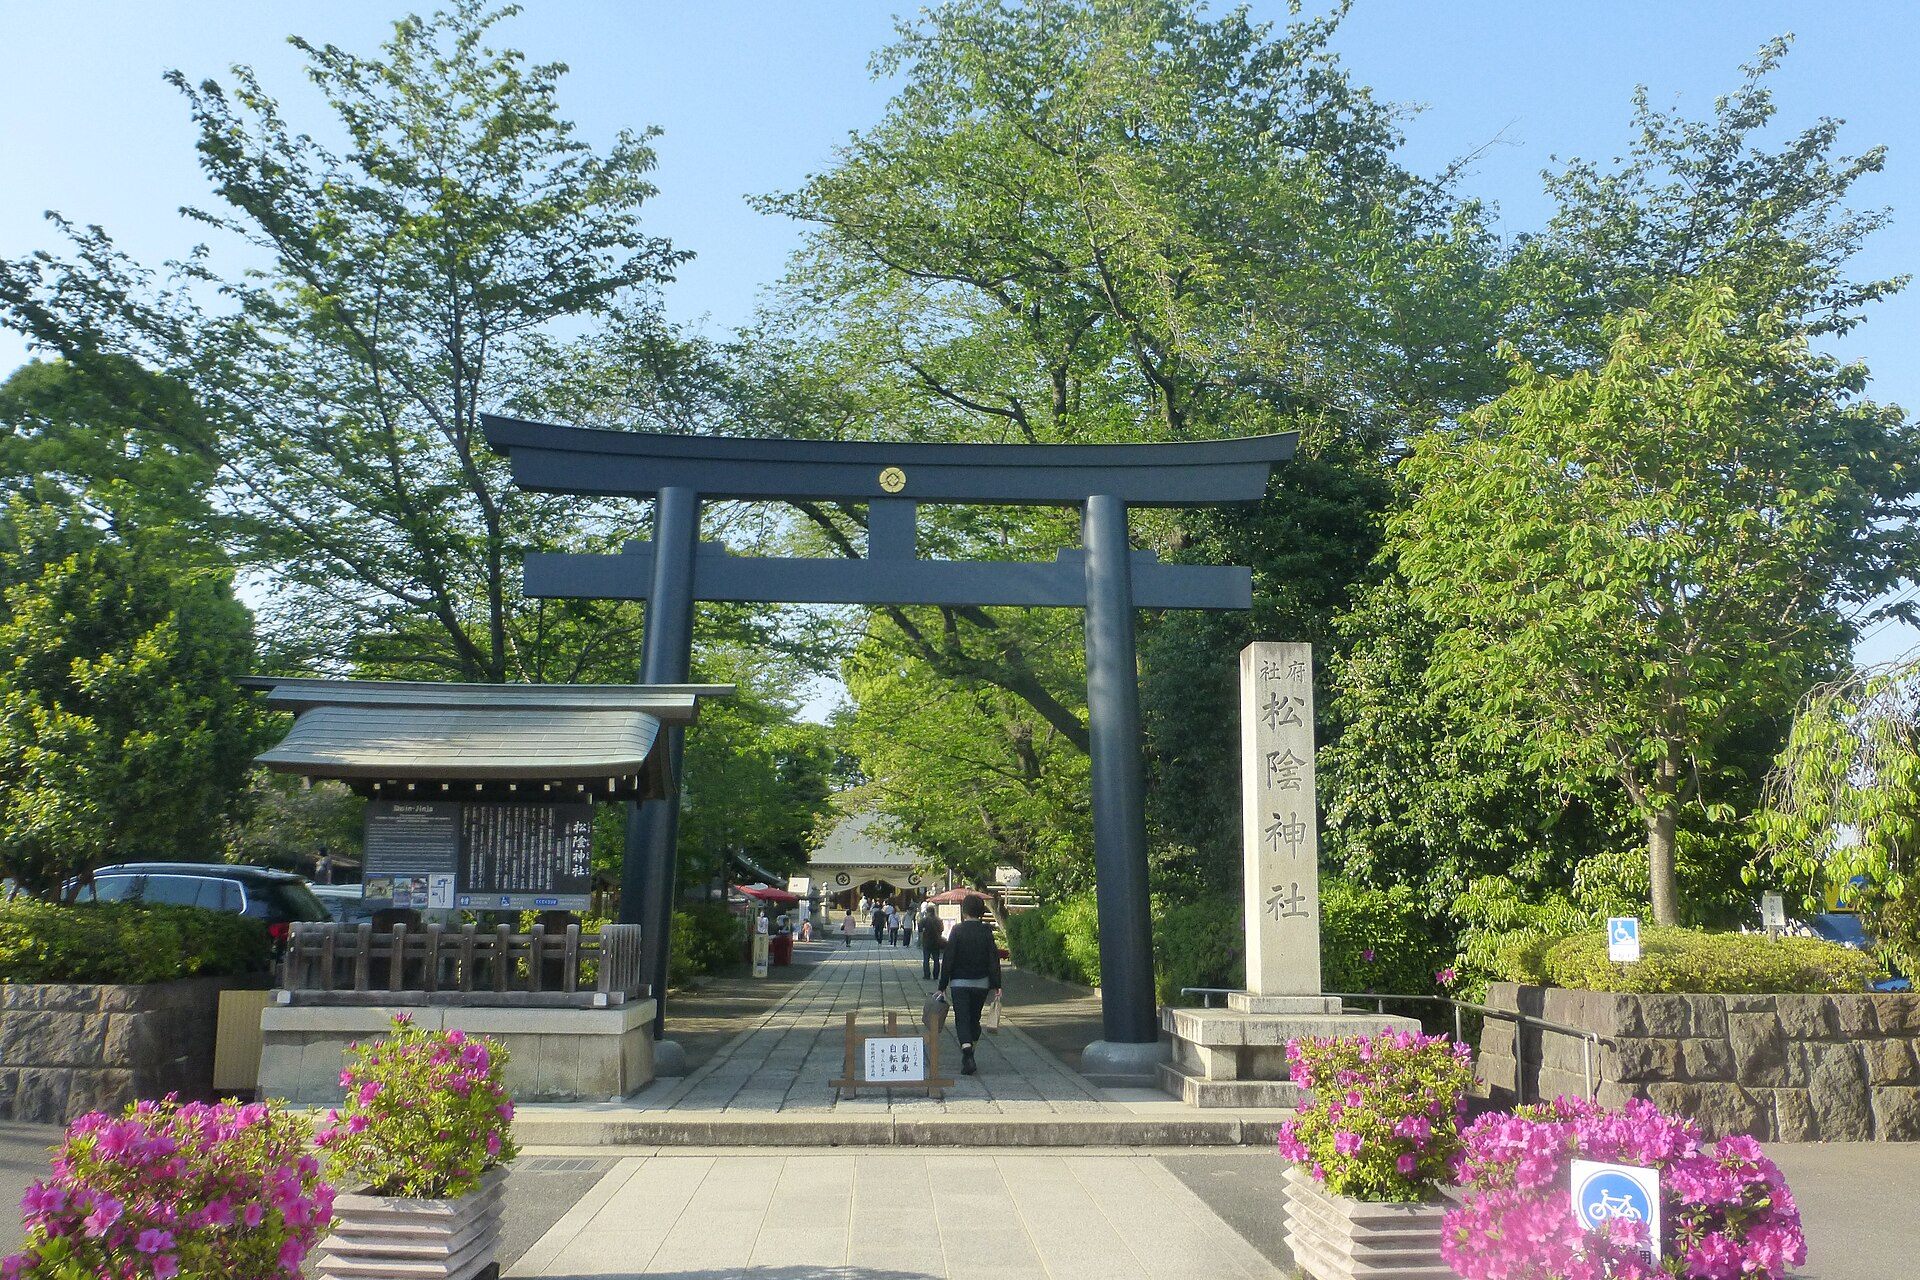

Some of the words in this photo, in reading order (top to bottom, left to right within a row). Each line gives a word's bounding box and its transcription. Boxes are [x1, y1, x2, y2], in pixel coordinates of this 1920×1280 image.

[1261, 691, 1310, 921] 松陰神社
[572, 820, 587, 878] 松陰神社
[889, 1043, 898, 1073] 自転車
[900, 1043, 910, 1073] 自動車
